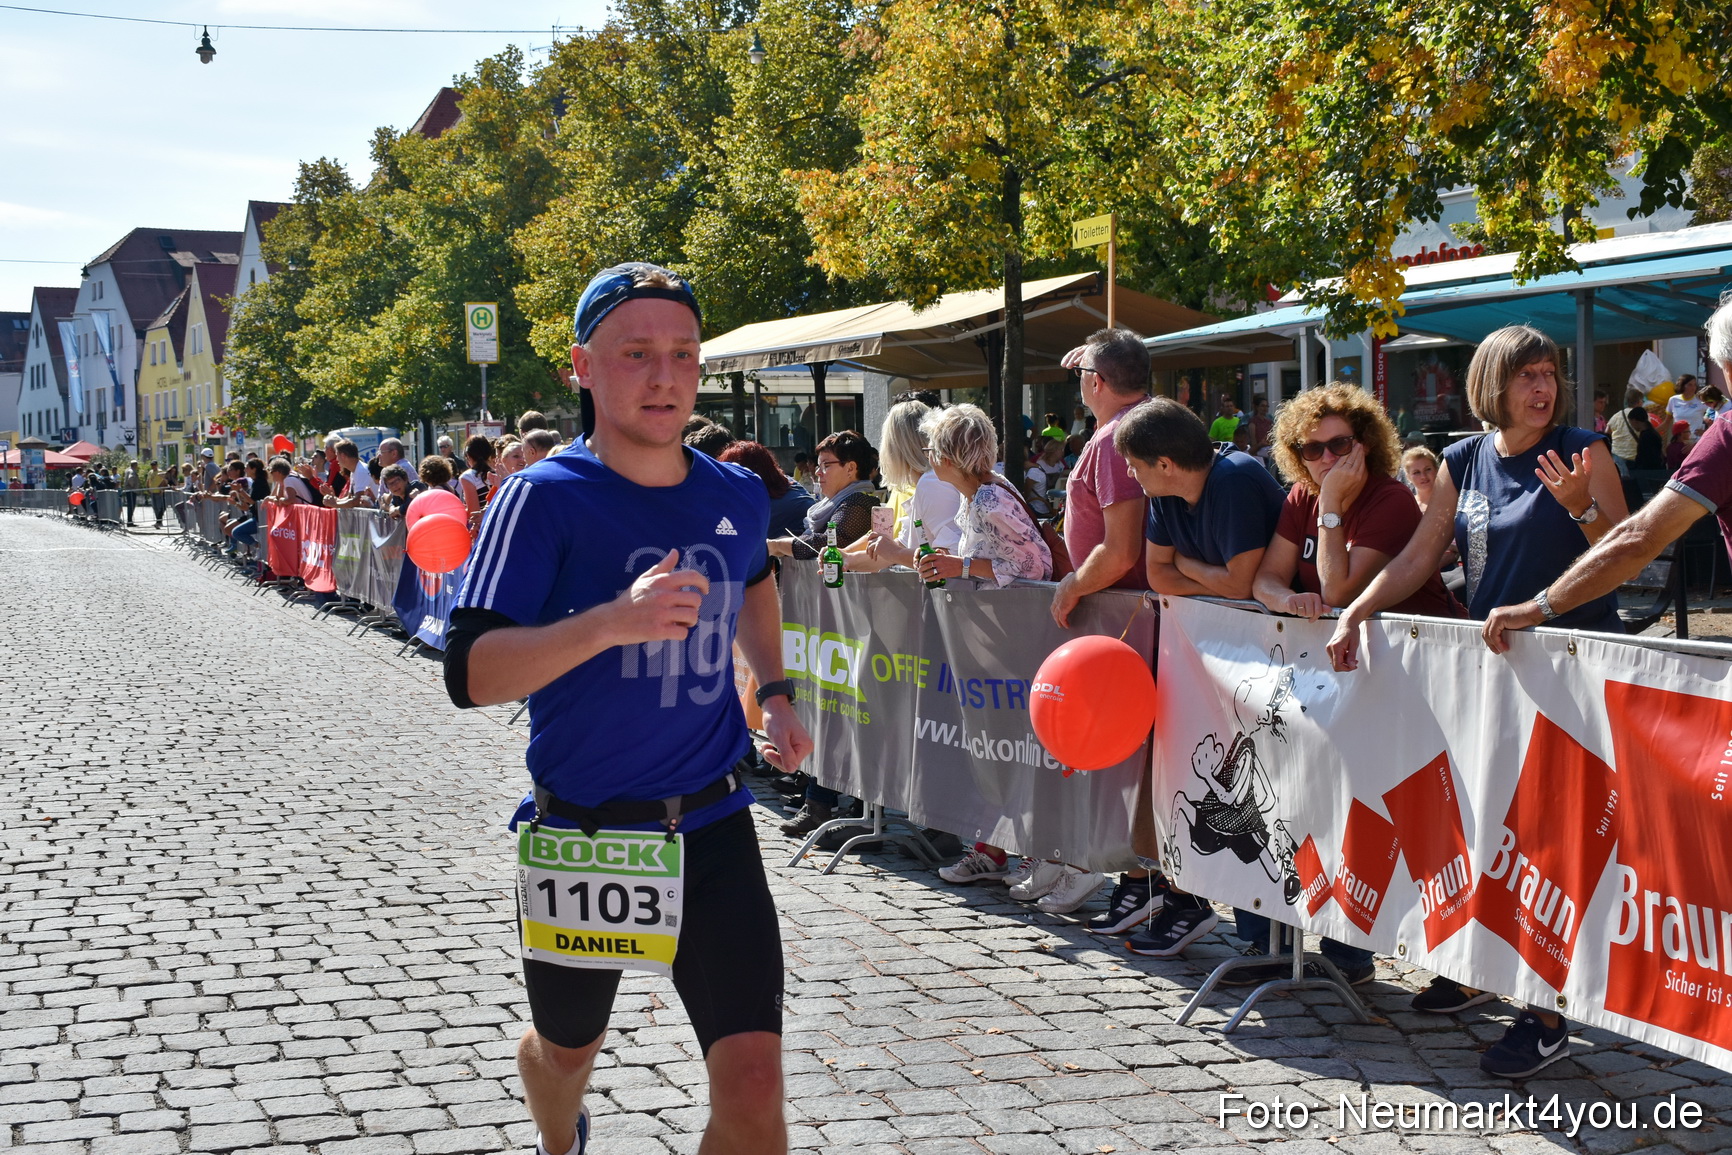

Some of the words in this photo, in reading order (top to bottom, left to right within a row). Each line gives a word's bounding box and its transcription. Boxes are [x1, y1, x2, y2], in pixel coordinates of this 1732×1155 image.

[1080, 225, 1109, 239] Toiletten
[715, 528, 738, 536] adidas
[1439, 767, 1449, 785] 1929
[1711, 771, 1729, 801] Seit
[1596, 816, 1611, 837] Seit
[1604, 789, 1619, 815] 1929
[531, 834, 668, 872] BOCK
[1387, 848, 1395, 861] Seit
[1301, 872, 1327, 904] Braun
[1337, 851, 1379, 912] Braun
[1414, 853, 1469, 920] Braun
[1483, 824, 1576, 945] Braun
[537, 878, 661, 926] 1103
[1354, 904, 1362, 914] ist
[1360, 910, 1376, 925] sicher
[1439, 904, 1456, 921] Sicher
[1455, 898, 1463, 910] ist
[555, 933, 645, 955] DANIEL
[1514, 907, 1535, 937] Sicher
[1534, 930, 1547, 948] ist
[1546, 943, 1572, 970] sicher
[1665, 969, 1703, 999] Sicher
[1706, 982, 1723, 1005] ist
